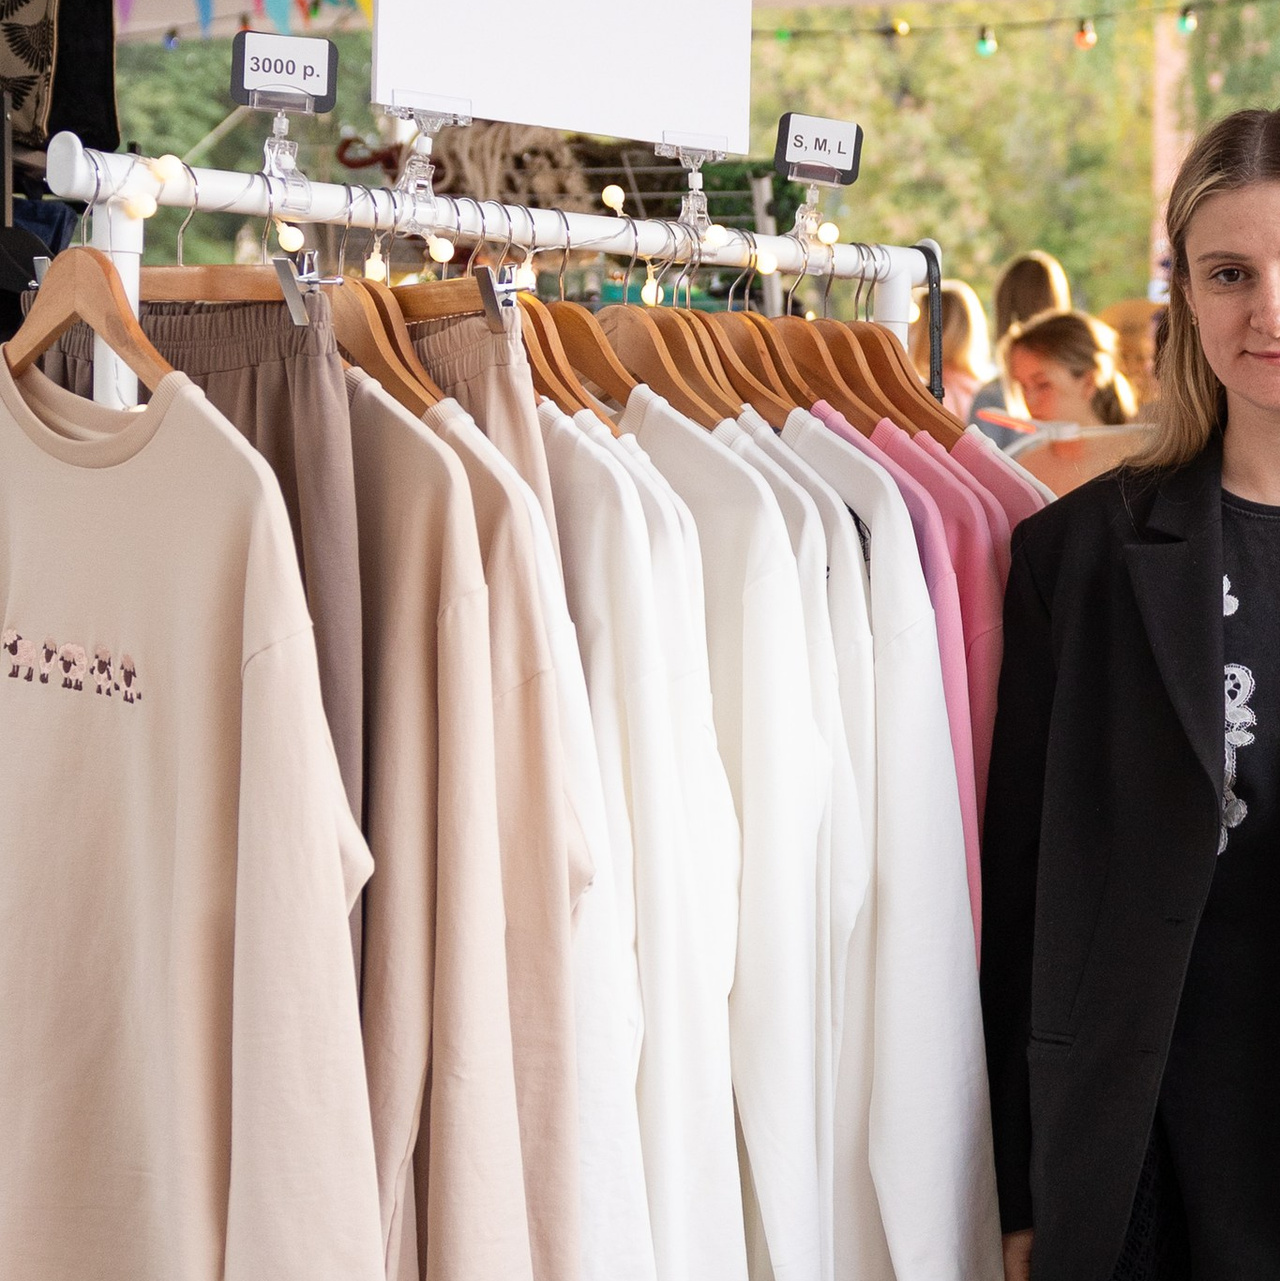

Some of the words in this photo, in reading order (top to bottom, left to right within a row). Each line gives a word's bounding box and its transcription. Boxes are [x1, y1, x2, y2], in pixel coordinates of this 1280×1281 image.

[250, 56, 296, 75] 3000
[303, 64, 320, 81] р.
[793, 134, 808, 152] S,
[813, 137, 831, 155] M,
[837, 140, 847, 155] L
